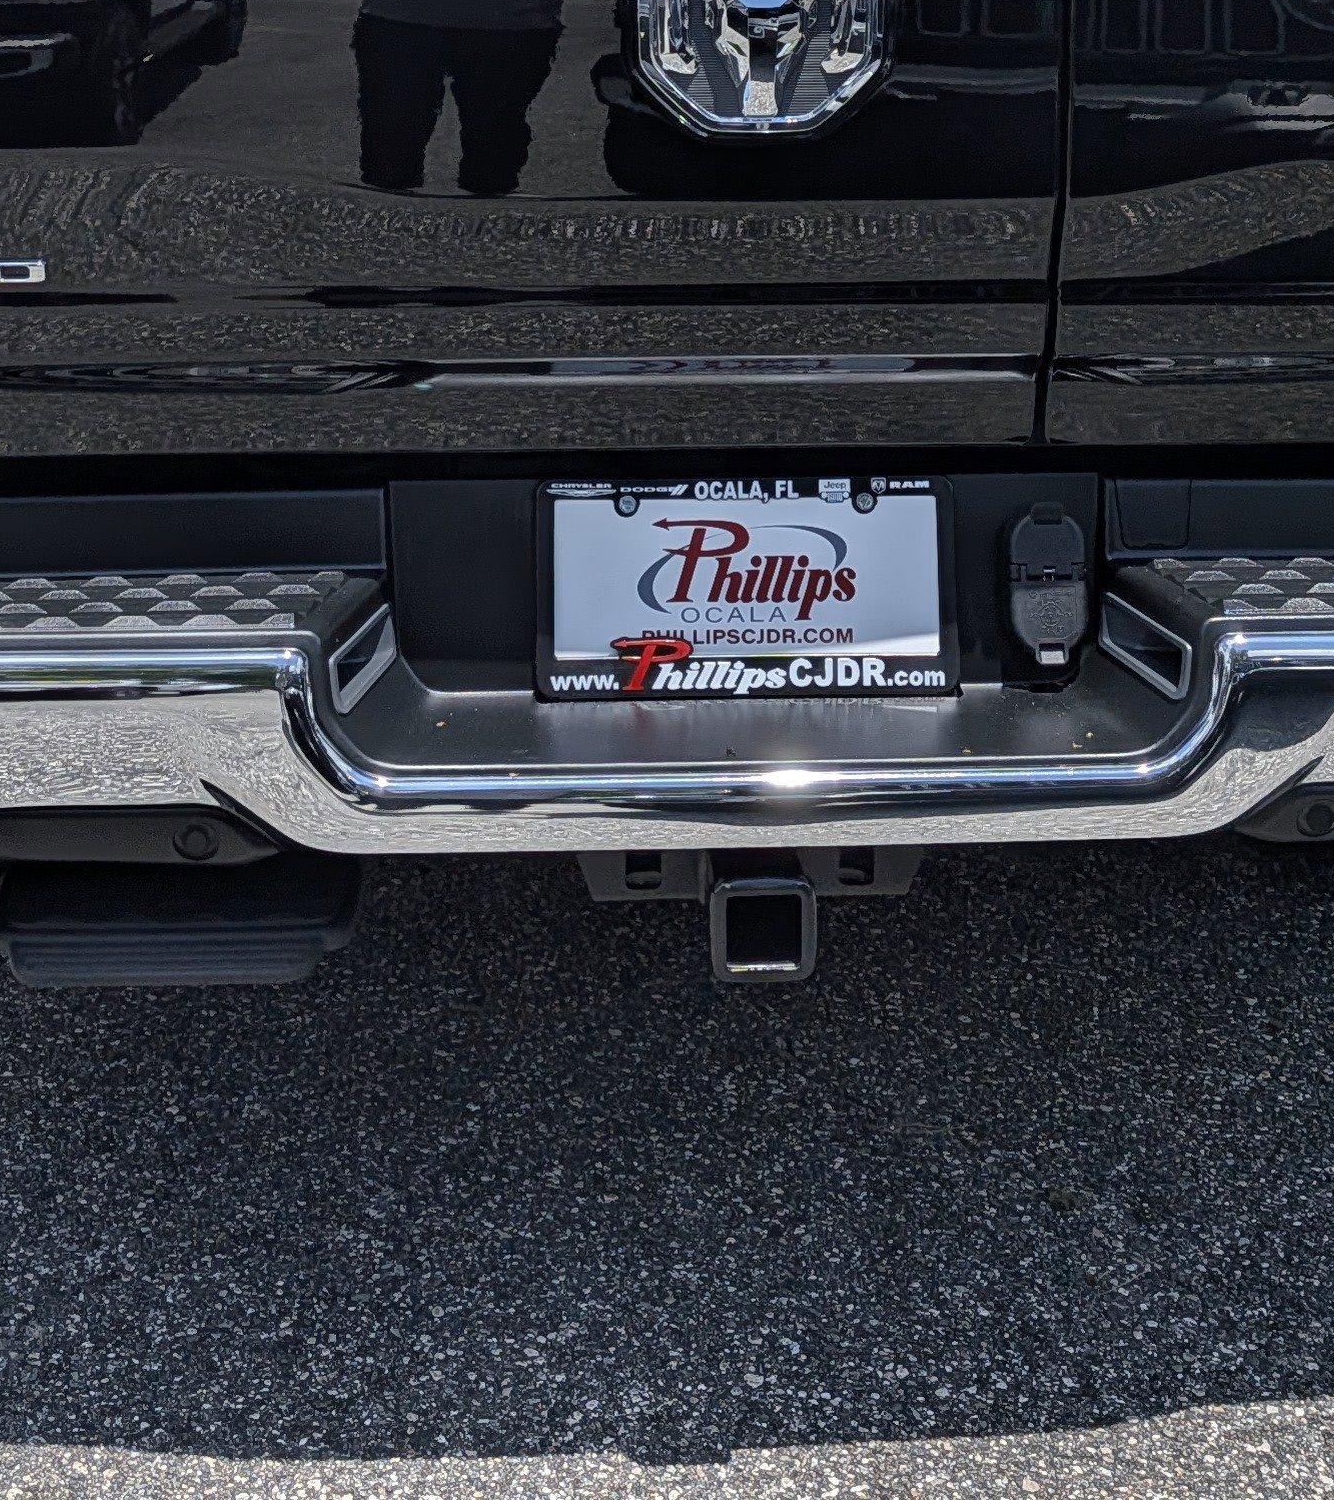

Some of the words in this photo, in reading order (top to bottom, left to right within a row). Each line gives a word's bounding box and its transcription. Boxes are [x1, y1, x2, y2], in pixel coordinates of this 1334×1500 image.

[694, 480, 769, 504] OCALA,
[774, 479, 800, 498] FL
[823, 481, 847, 491] Jeep
[889, 480, 930, 489] RAM
[652, 518, 857, 622] Phillips
[680, 607, 787, 624] OCALA
[550, 637, 946, 695] www.PhillipsCJDR.com
